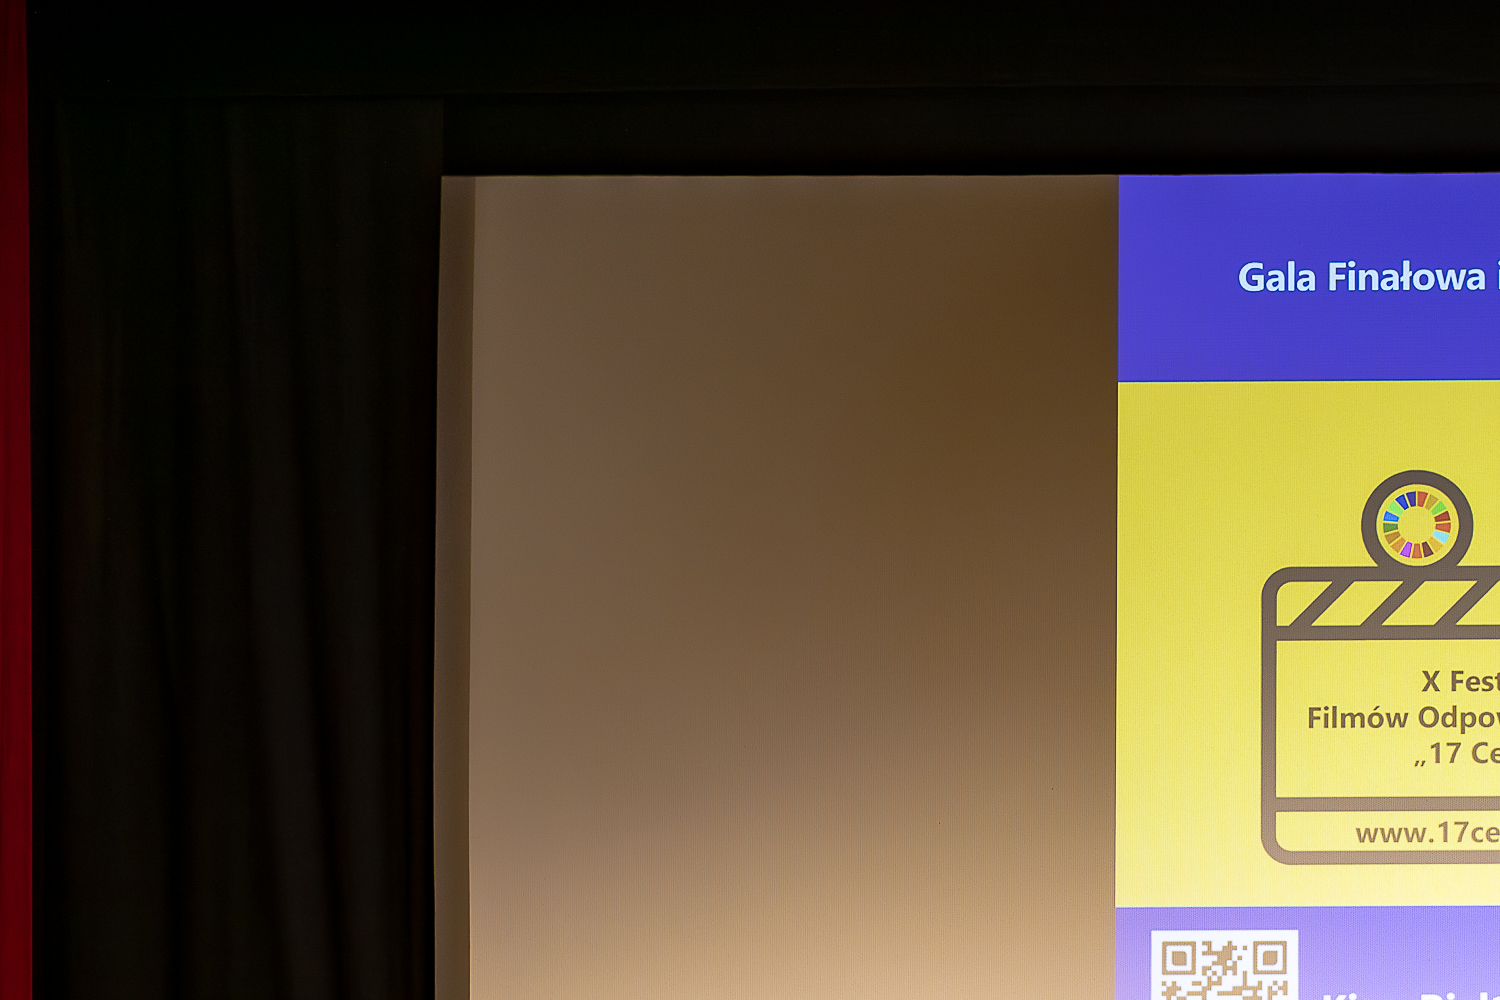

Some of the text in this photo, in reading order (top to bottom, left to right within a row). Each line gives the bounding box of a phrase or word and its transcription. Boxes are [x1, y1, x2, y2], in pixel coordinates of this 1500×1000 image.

[1238, 260, 1316, 292] Gala
[1329, 260, 1486, 292] Finałowa
[1421, 670, 1441, 692] X
[1307, 704, 1409, 729] Filmów
[1414, 741, 1462, 767] „17
